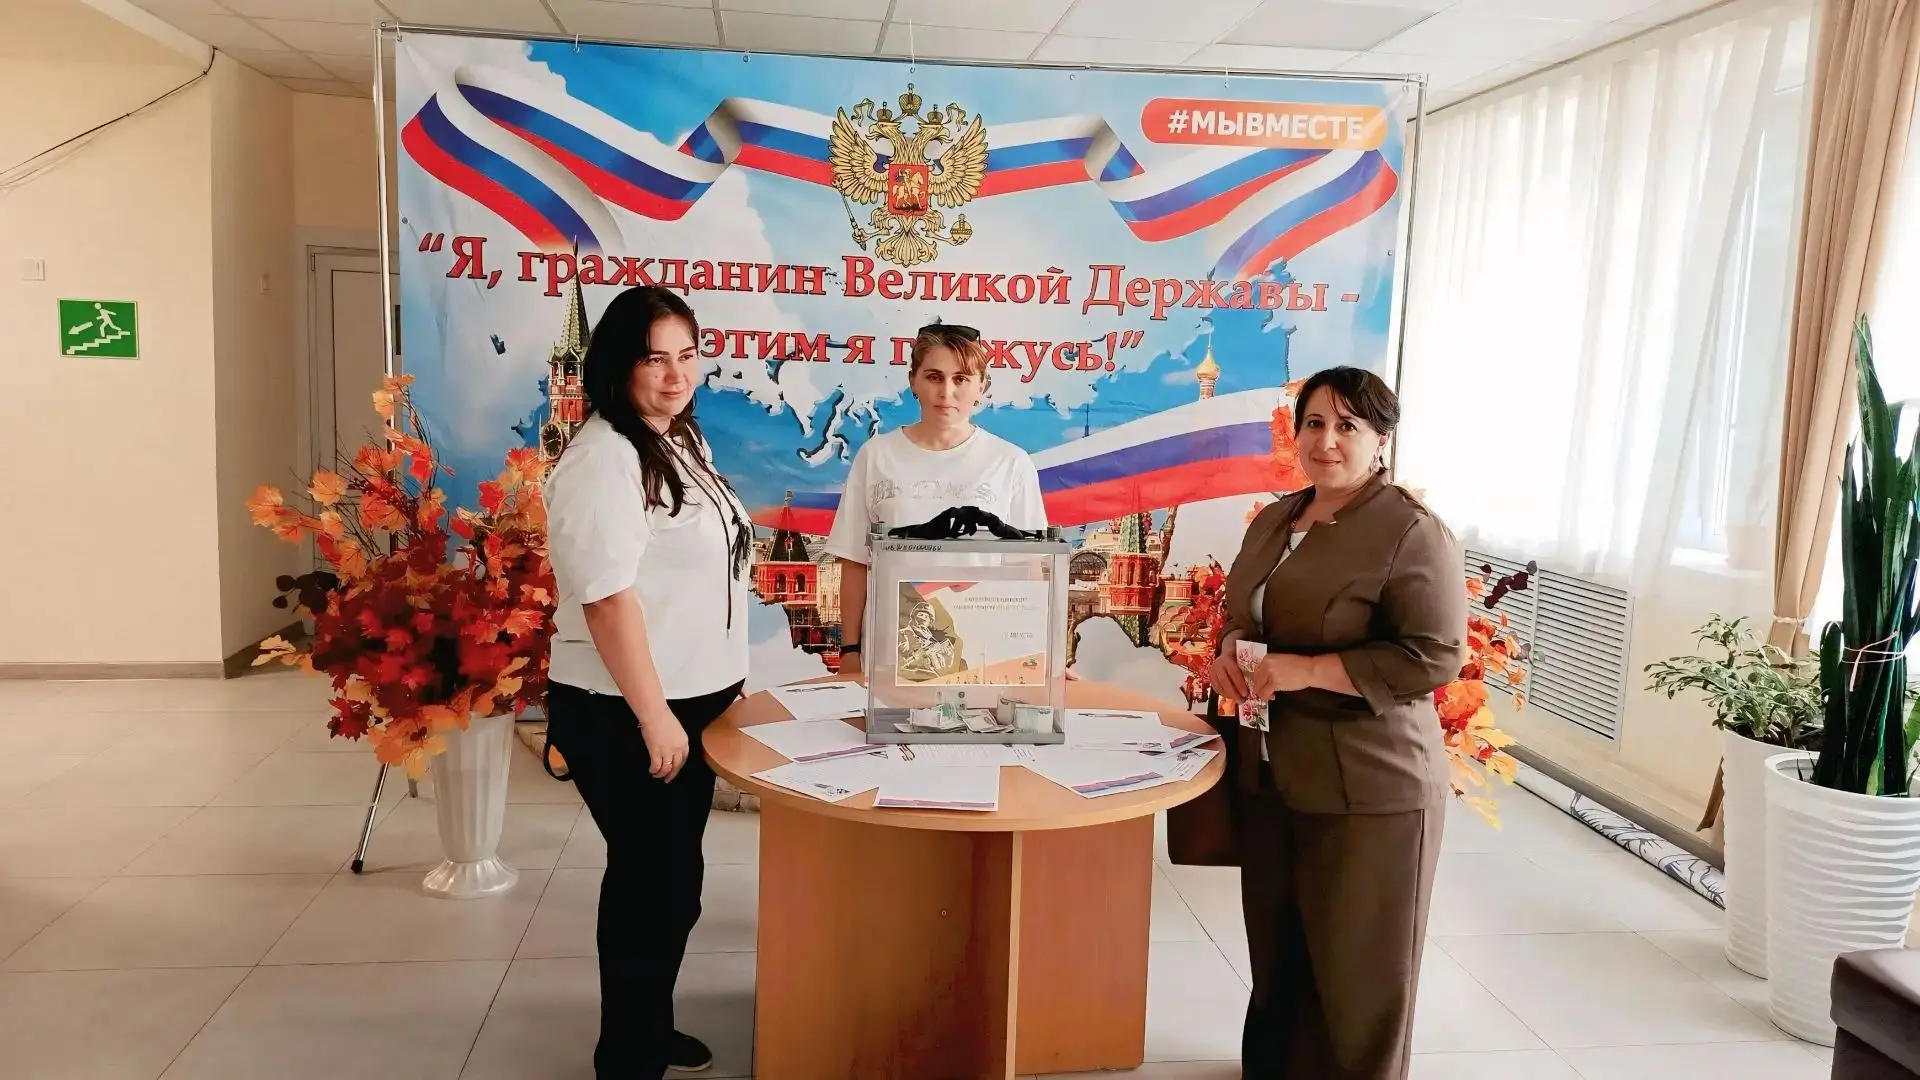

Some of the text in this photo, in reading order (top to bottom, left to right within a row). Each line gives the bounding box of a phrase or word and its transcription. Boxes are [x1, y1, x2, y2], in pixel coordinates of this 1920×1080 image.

[1167, 109, 1364, 141] #МЫВМЕСТЕ
[517, 252, 827, 297] гражданин
[843, 256, 1071, 303] Великой
[1082, 265, 1329, 320] Державы
[700, 327, 831, 362] этим
[843, 335, 876, 365] я
